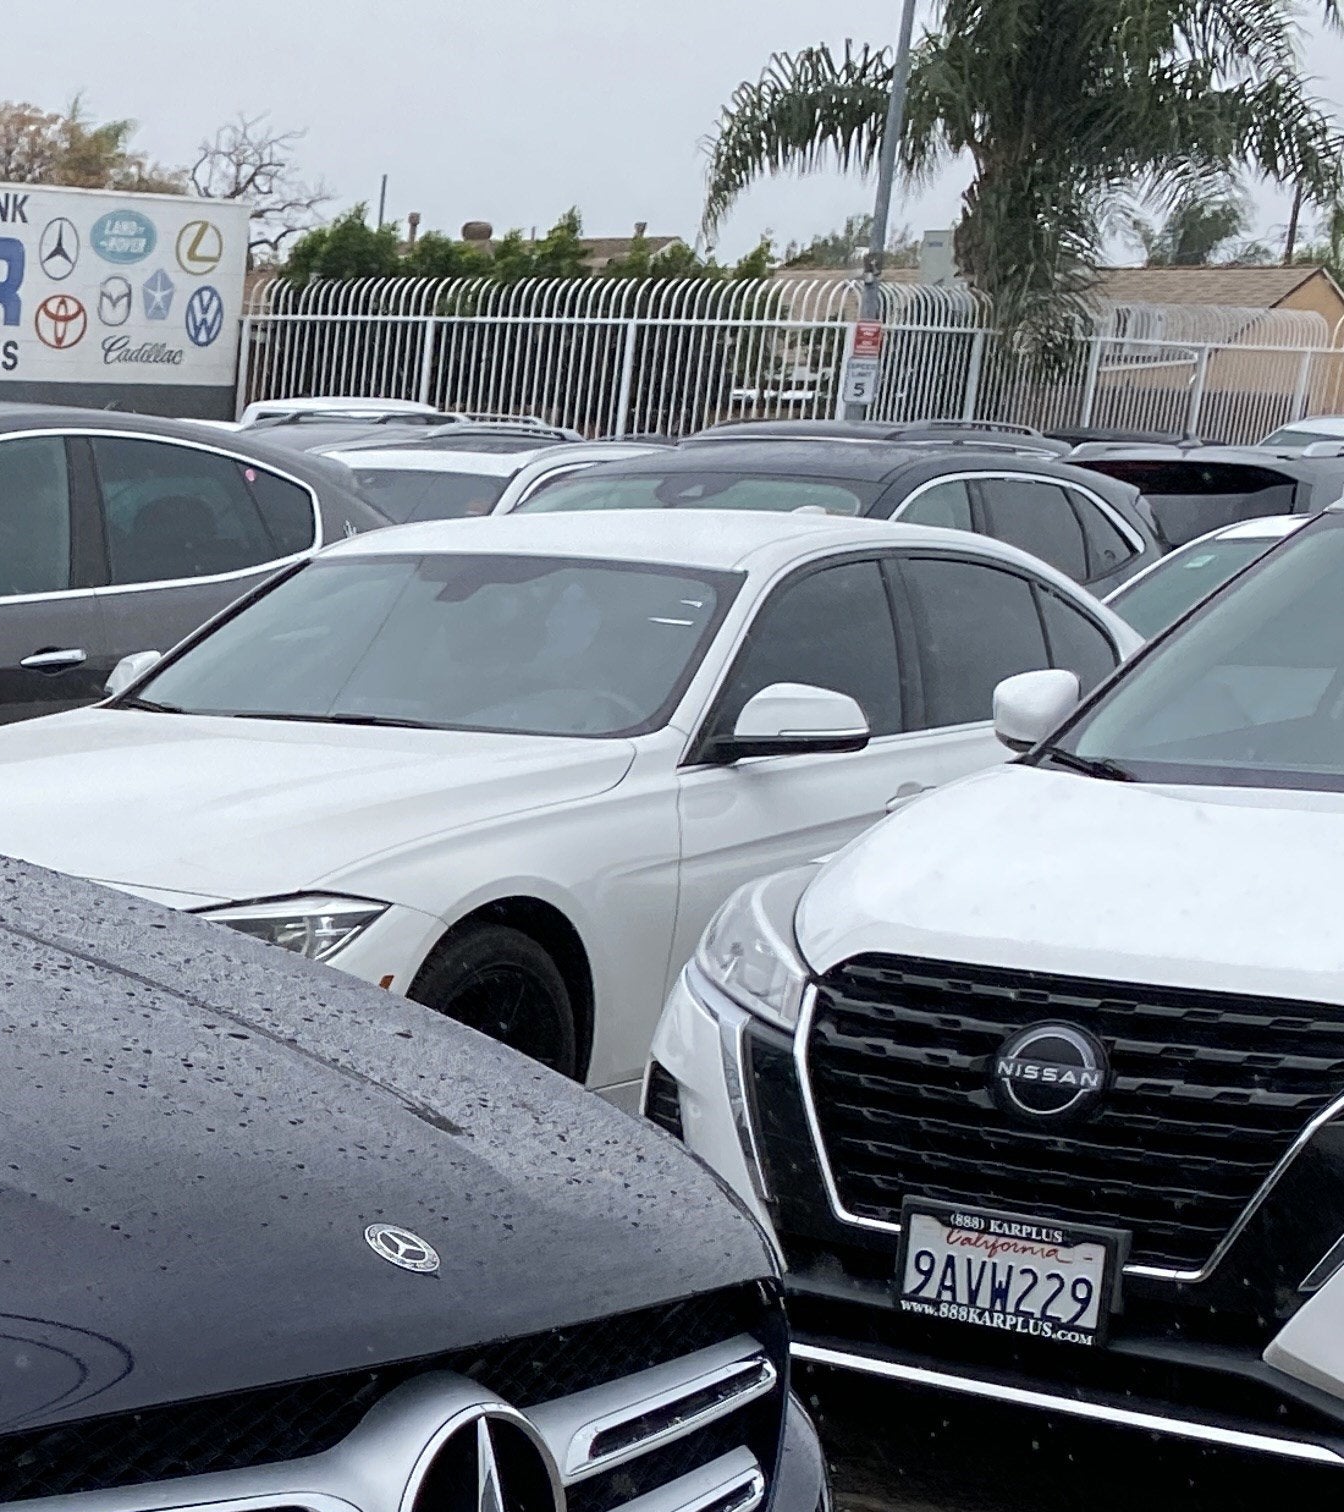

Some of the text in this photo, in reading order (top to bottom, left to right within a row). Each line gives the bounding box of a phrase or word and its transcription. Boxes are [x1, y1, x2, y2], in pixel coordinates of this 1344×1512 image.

[101, 335, 184, 365] Cadillac
[853, 382, 865, 397] 5
[997, 1060, 1099, 1087] NISSAN
[949, 1213, 1063, 1243] (888) KARPLUS
[946, 1228, 1073, 1264] California
[909, 1249, 1094, 1325] 9AVW229
